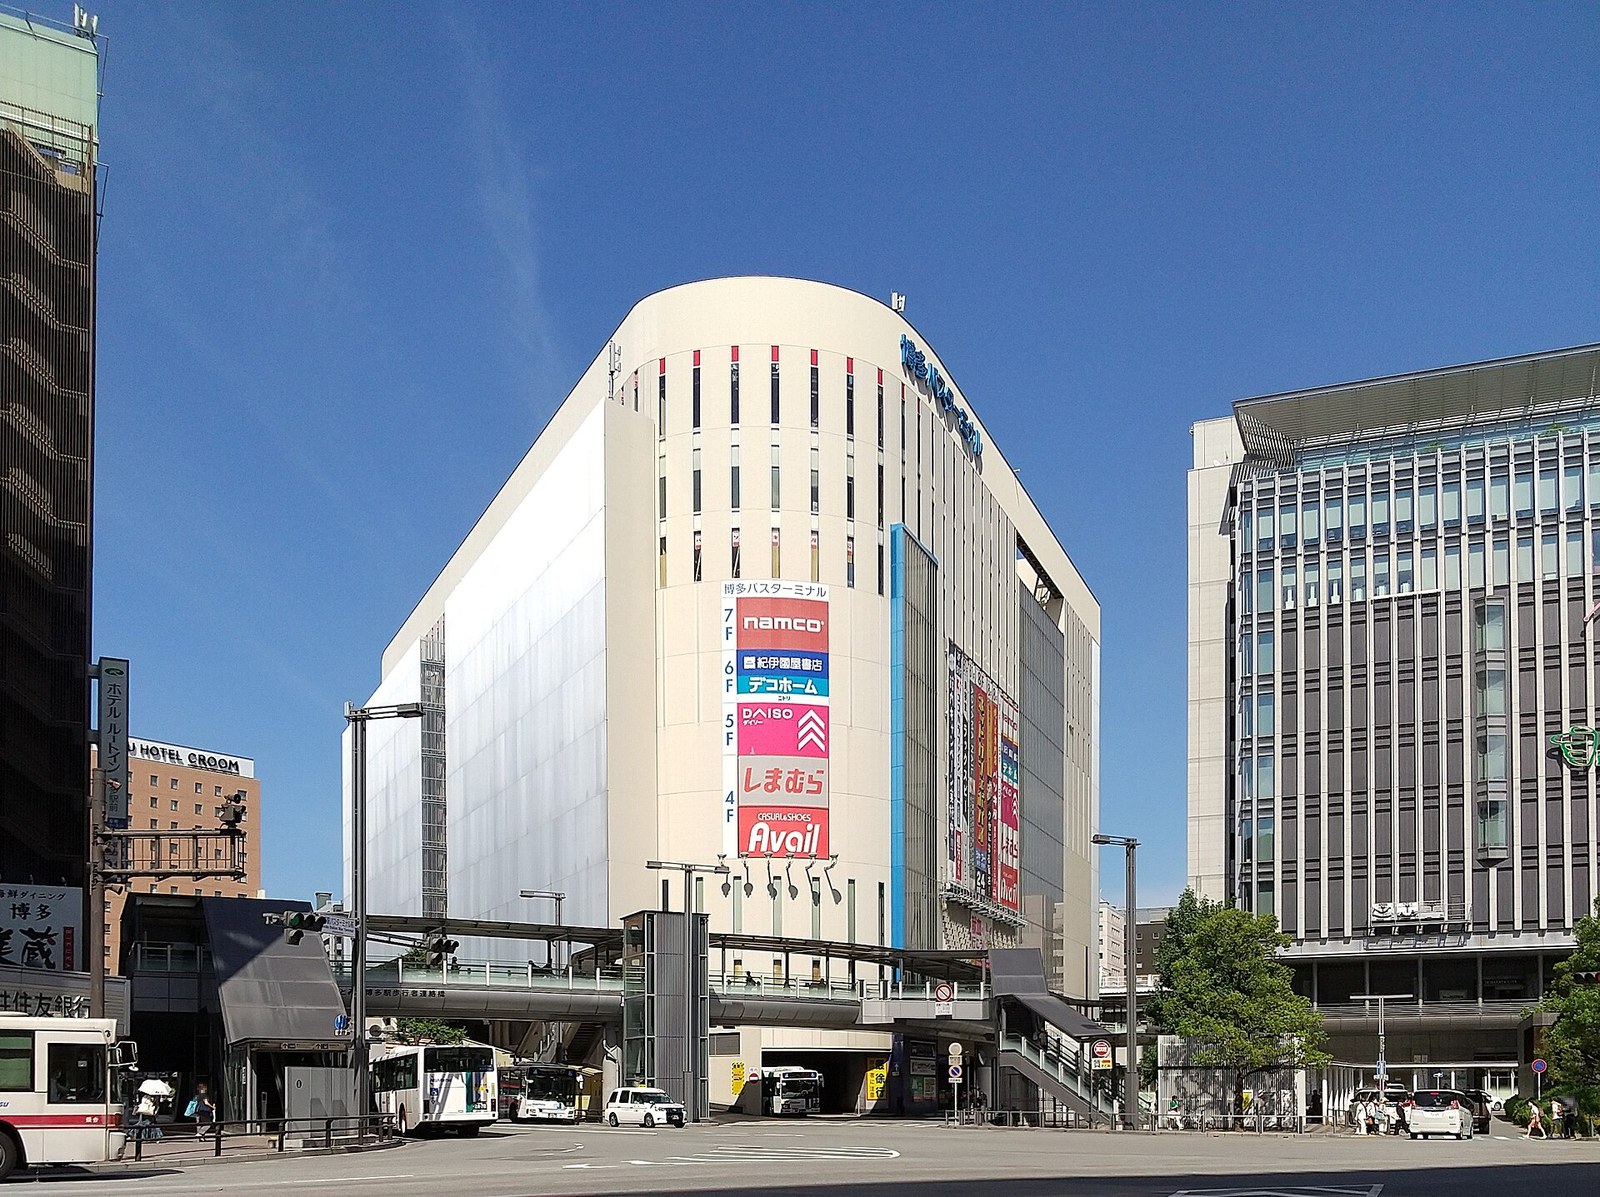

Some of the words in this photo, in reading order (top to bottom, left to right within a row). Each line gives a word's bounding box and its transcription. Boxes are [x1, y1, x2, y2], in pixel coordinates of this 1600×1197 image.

[724, 583, 827, 598] 博多バスターミナル
[743, 616, 822, 633] namco
[748, 676, 818, 694] デコホーム
[107, 682, 122, 719] ホテル
[742, 707, 794, 719] DAISO
[107, 722, 122, 773] ルートイン
[140, 743, 183, 761] HOTEL
[187, 752, 240, 772] CROOM
[743, 767, 825, 795] しまむら
[748, 821, 821, 854] Avail
[9, 902, 52, 921] 博多
